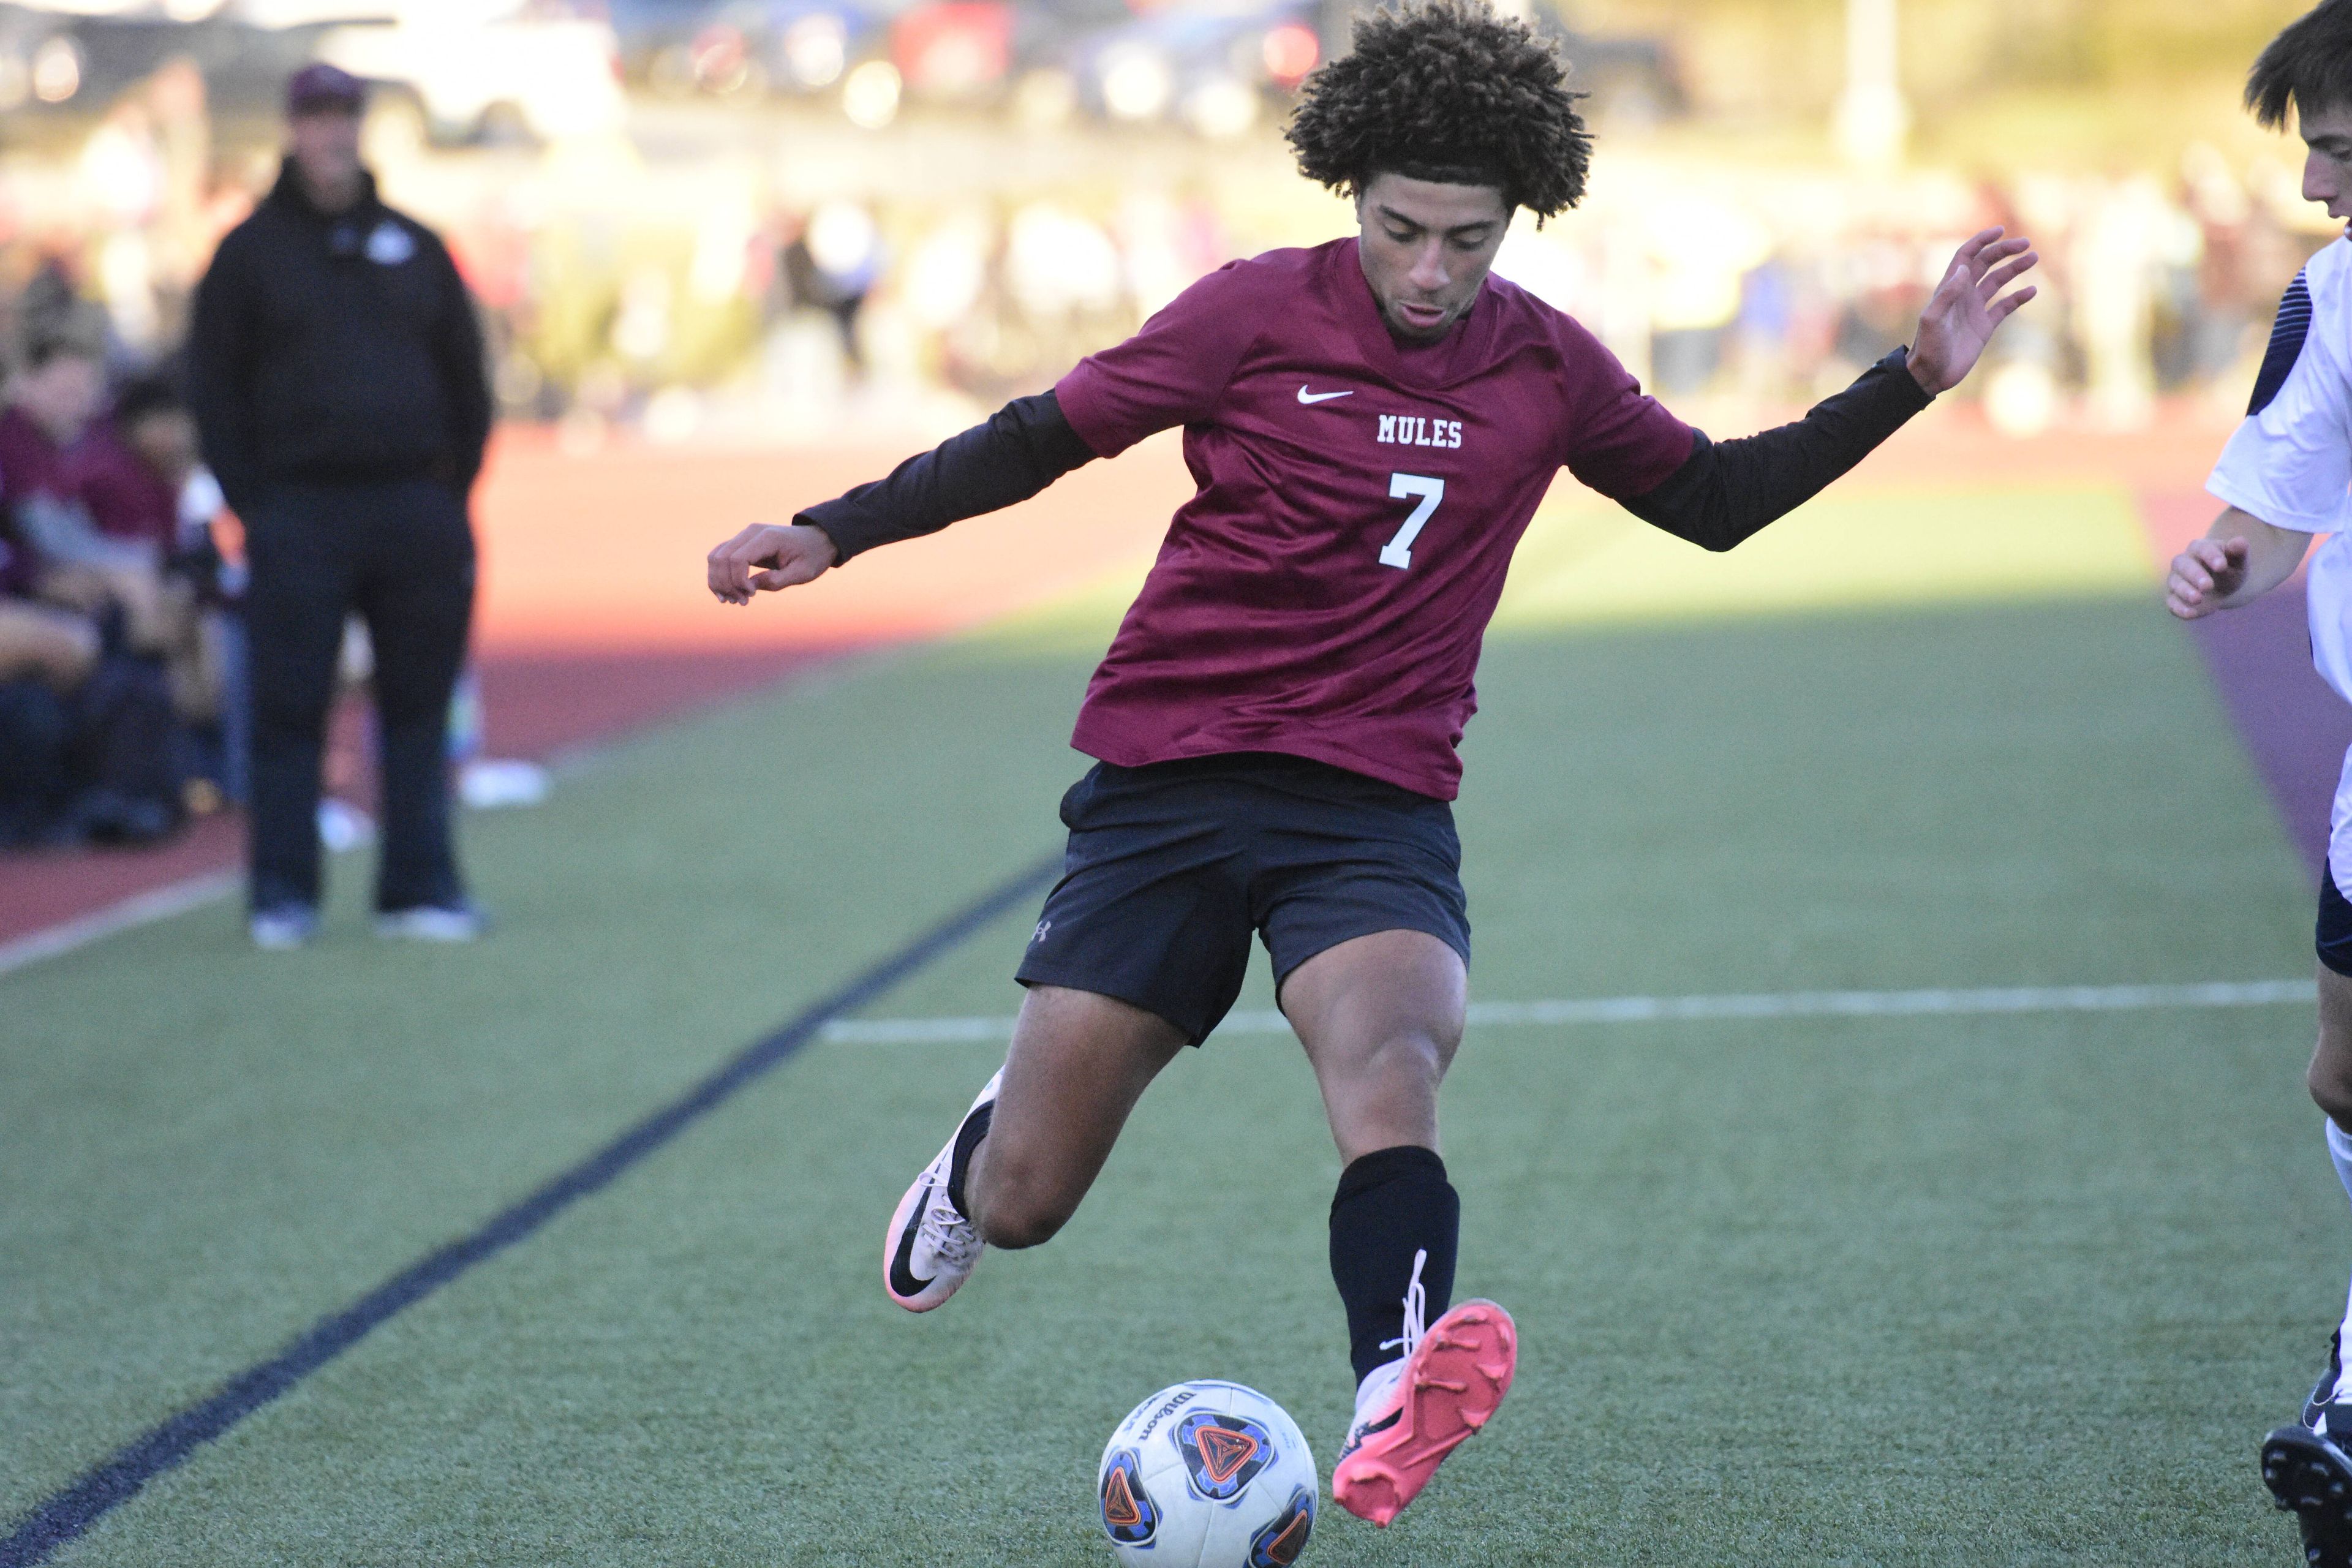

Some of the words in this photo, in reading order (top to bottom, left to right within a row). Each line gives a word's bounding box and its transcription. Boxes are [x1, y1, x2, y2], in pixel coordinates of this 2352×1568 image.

[1377, 415, 1462, 448] MULES
[1379, 472, 1445, 570] 7
[1138, 1392, 1197, 1441] Wilson
